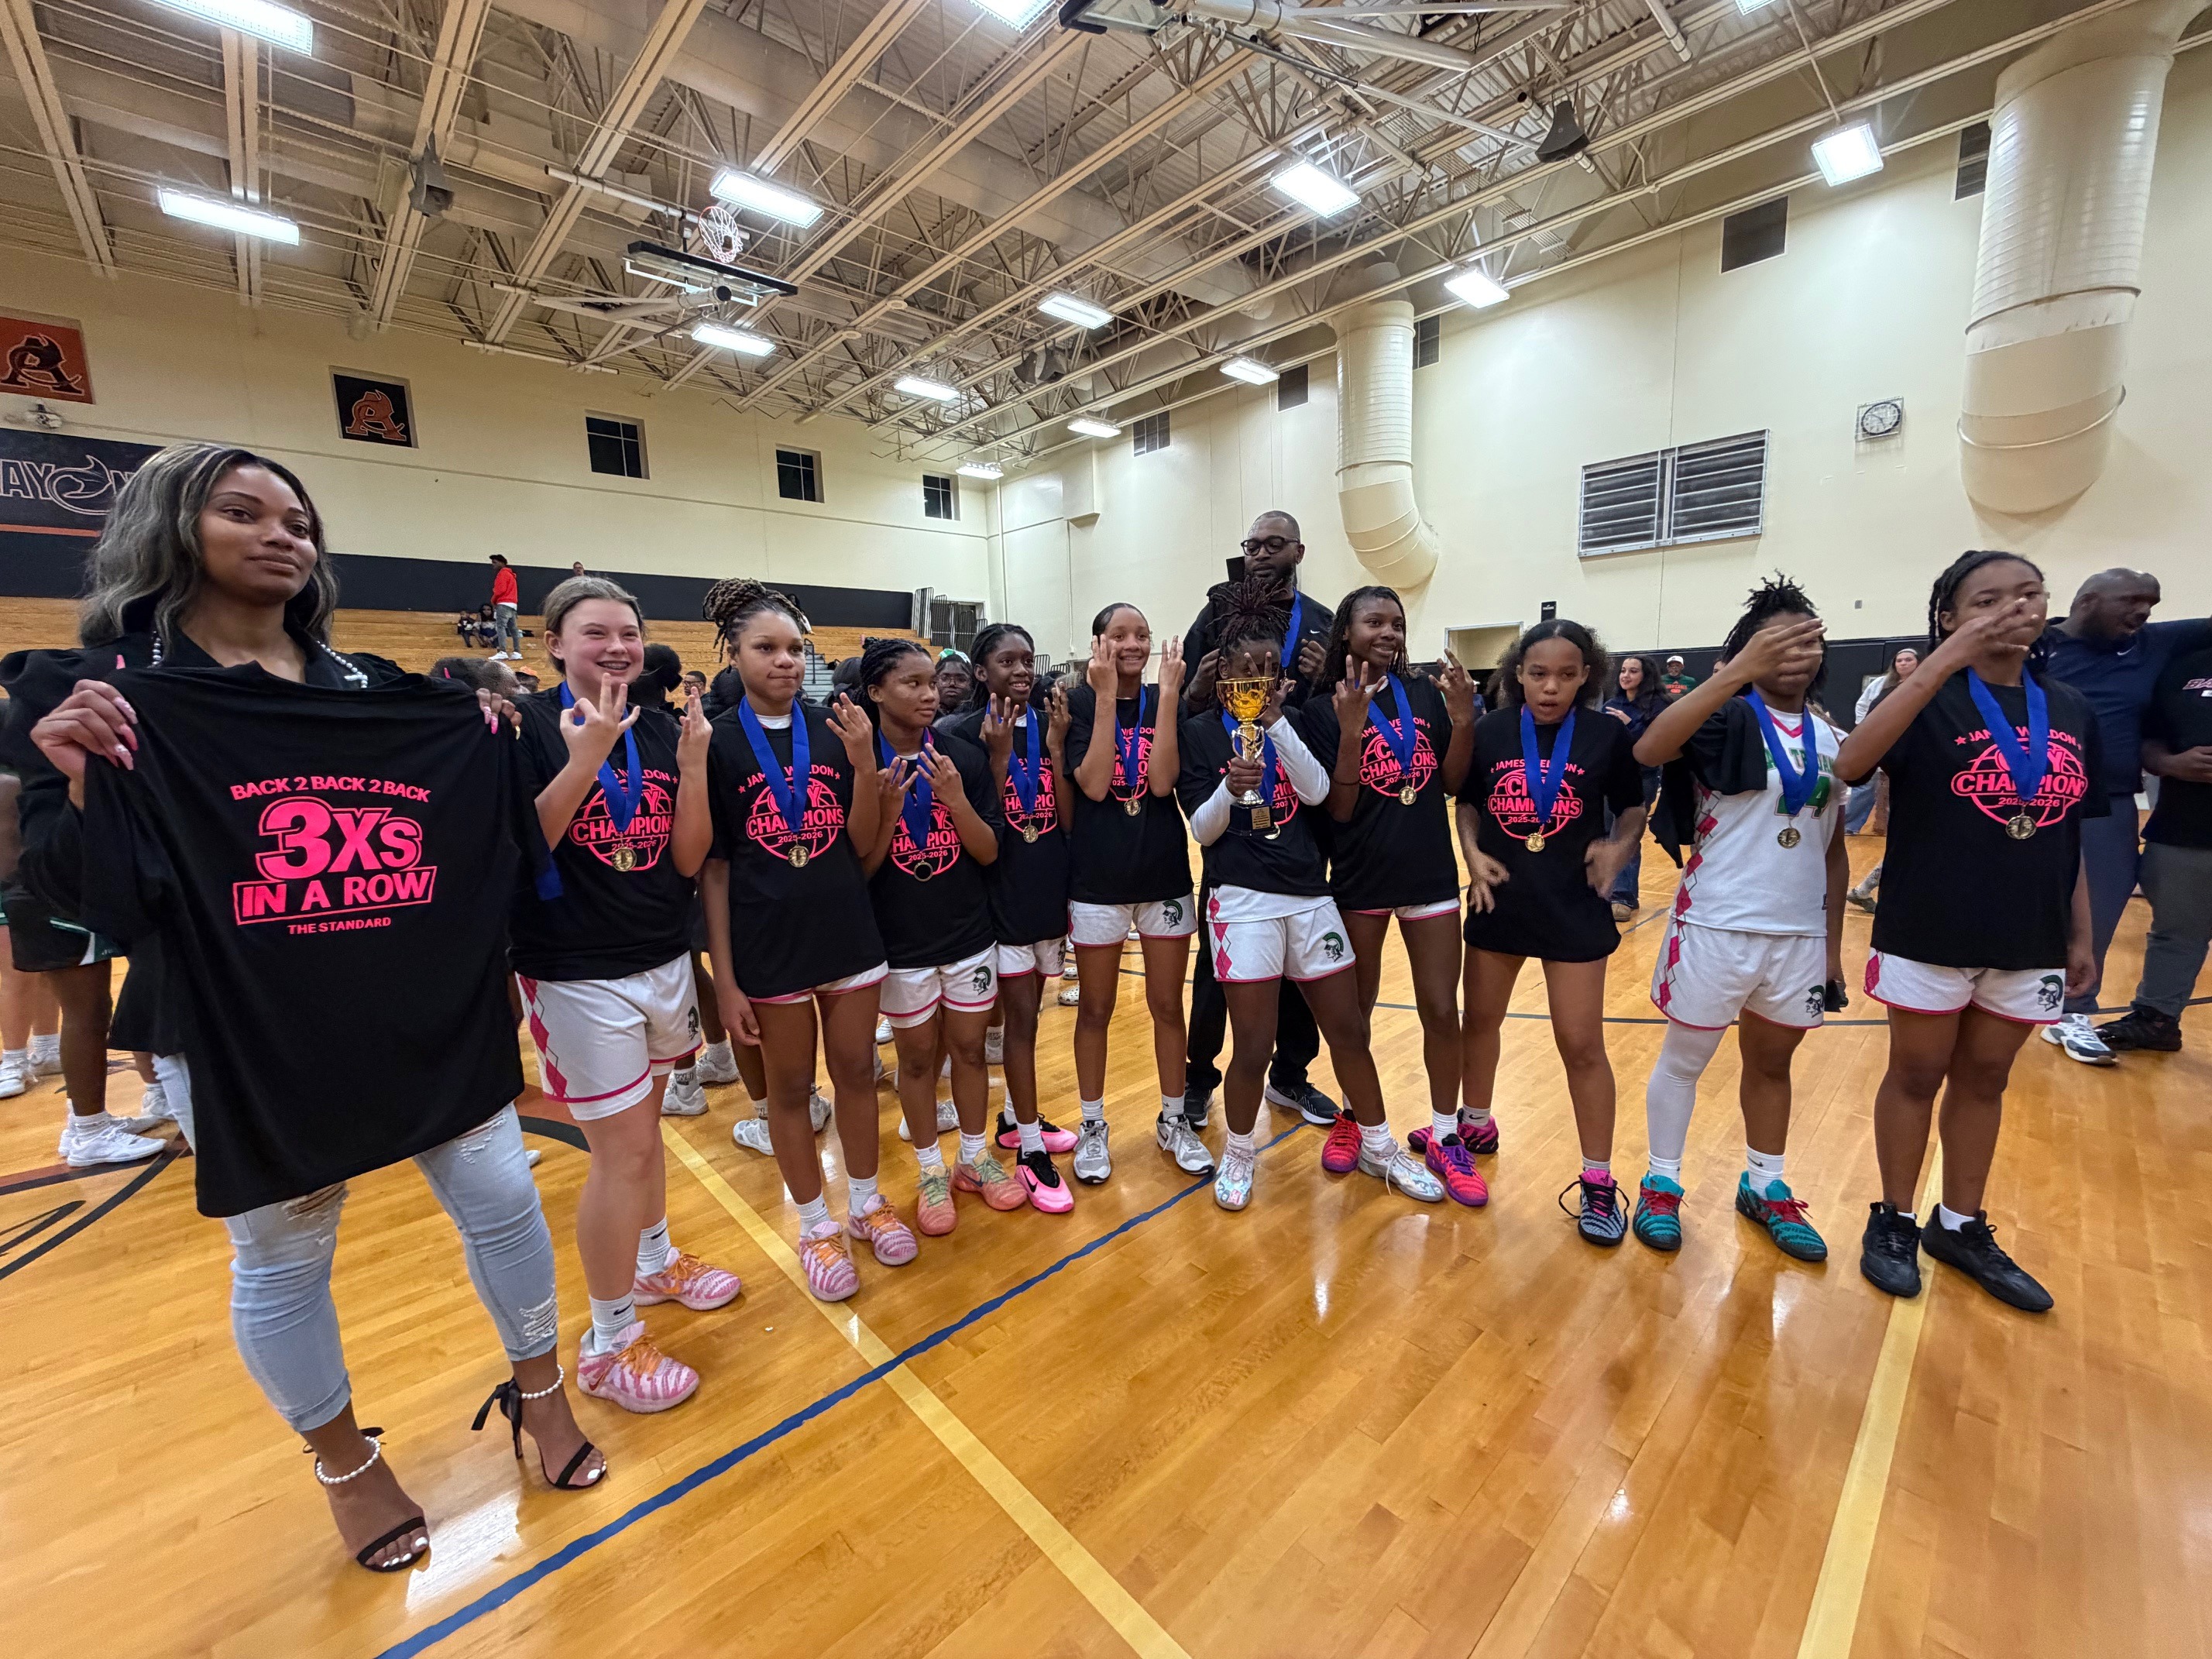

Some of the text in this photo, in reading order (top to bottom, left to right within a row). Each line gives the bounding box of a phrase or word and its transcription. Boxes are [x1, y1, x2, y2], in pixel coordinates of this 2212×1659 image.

[1121, 727, 1155, 736] WEDO
[1362, 725, 1379, 738] AME
[1969, 726, 2076, 746] JAM WDON
[747, 764, 833, 787] JAM WDON
[1359, 752, 1437, 782] CHAMONS
[1496, 759, 1526, 771] JAMES
[230, 776, 431, 802] BACK 2 BACK 2 BACK
[1956, 774, 2085, 797] CHAPION
[1490, 797, 1580, 816] CHAMPNS
[748, 808, 844, 836] CHAPIONS
[892, 830, 960, 854] HAPION
[242, 872, 430, 917] IN A ROW
[287, 917, 391, 934] THE STANDARD
